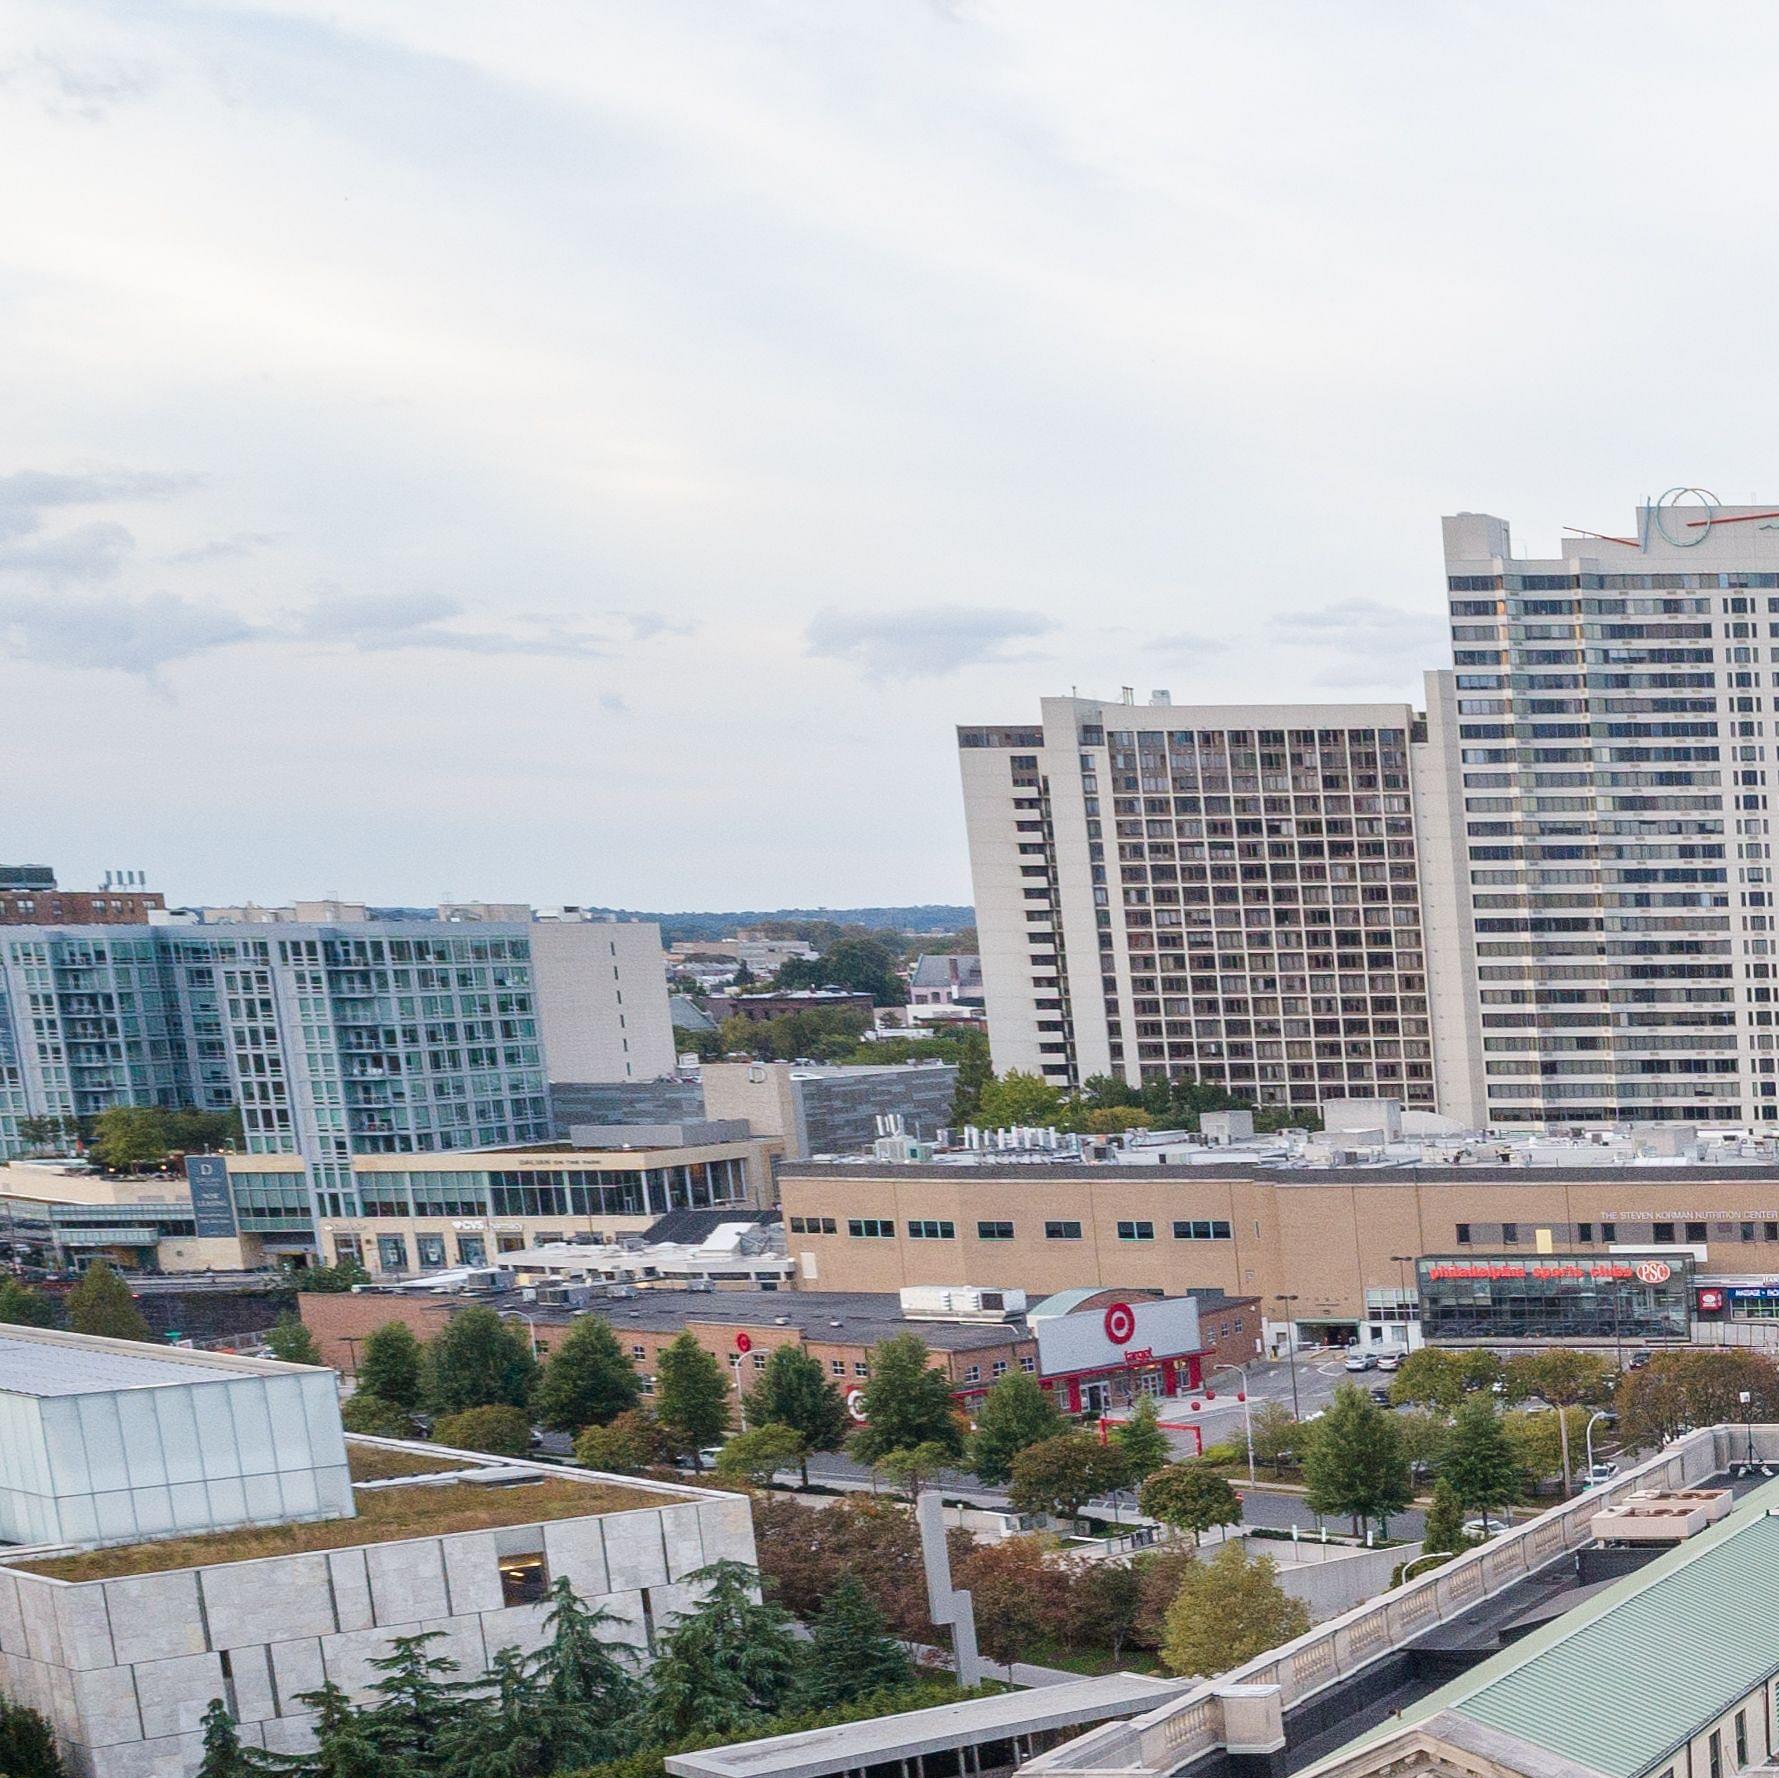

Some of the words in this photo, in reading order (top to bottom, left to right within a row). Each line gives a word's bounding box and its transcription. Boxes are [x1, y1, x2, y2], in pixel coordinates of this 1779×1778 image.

[1601, 1211, 1617, 1220] THE
[1620, 1211, 1654, 1220] STEVEN
[1655, 1211, 1693, 1220] KORMAN
[1694, 1211, 1741, 1220] NUTRITION
[1743, 1211, 1778, 1220] CENTER
[1429, 1265, 1526, 1281] philadelphia
[1532, 1264, 1584, 1280] sports
[1590, 1264, 1633, 1278] clubs
[1642, 1264, 1667, 1281] PSC
